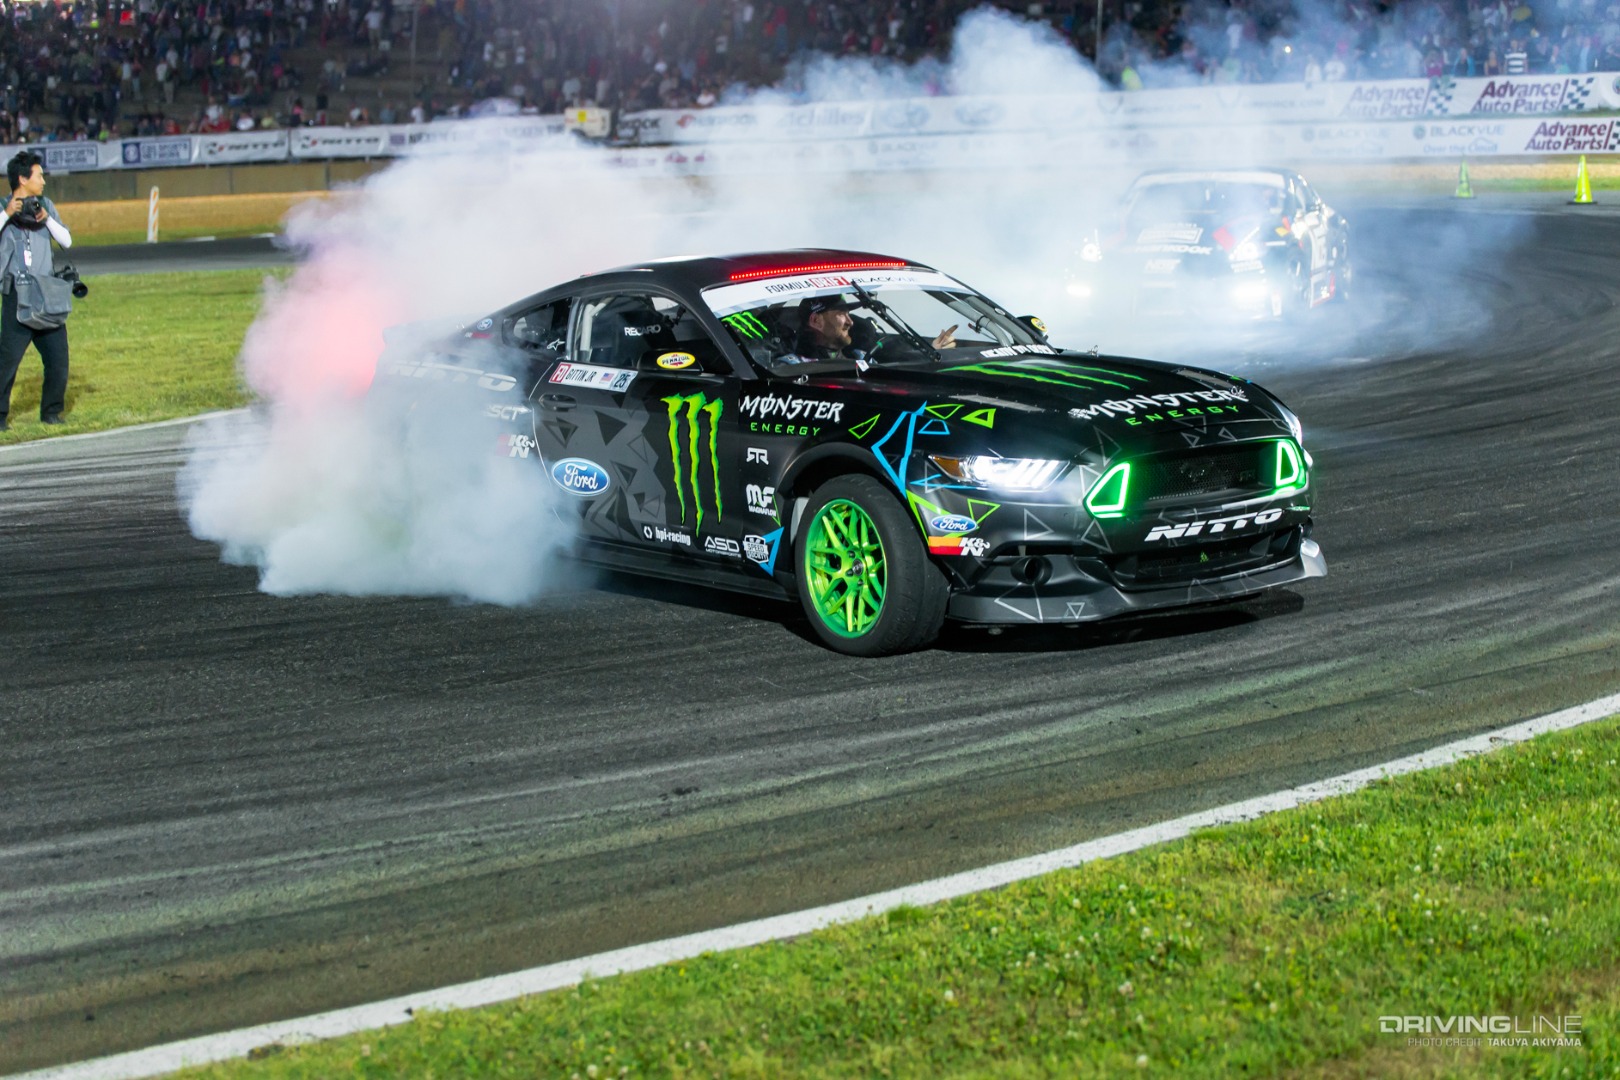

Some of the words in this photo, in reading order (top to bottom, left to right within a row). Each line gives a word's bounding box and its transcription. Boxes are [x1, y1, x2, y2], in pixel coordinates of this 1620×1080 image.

[1480, 81, 1561, 99] Advance
[1471, 99, 1510, 114] Auto
[1513, 98, 1560, 112] Parts
[1533, 121, 1607, 138] Advance
[1525, 137, 1560, 151] Auto
[1563, 135, 1605, 151] Parts
[765, 280, 814, 294] FORMULA
[814, 277, 850, 288] DRIFT
[624, 324, 661, 336] RECARO
[614, 373, 631, 388] 25
[740, 393, 844, 424] MONSTER
[1068, 388, 1249, 420] MONSTER
[487, 405, 524, 421] SCT
[1125, 405, 1240, 427] ENERGY
[750, 422, 821, 437] ENERGY
[563, 463, 599, 490] Ford
[939, 516, 969, 531] Ford
[1144, 508, 1283, 542] NITTO
[655, 526, 691, 546] hpi-racing
[704, 535, 740, 553] ASD
[959, 537, 991, 557] K&N
